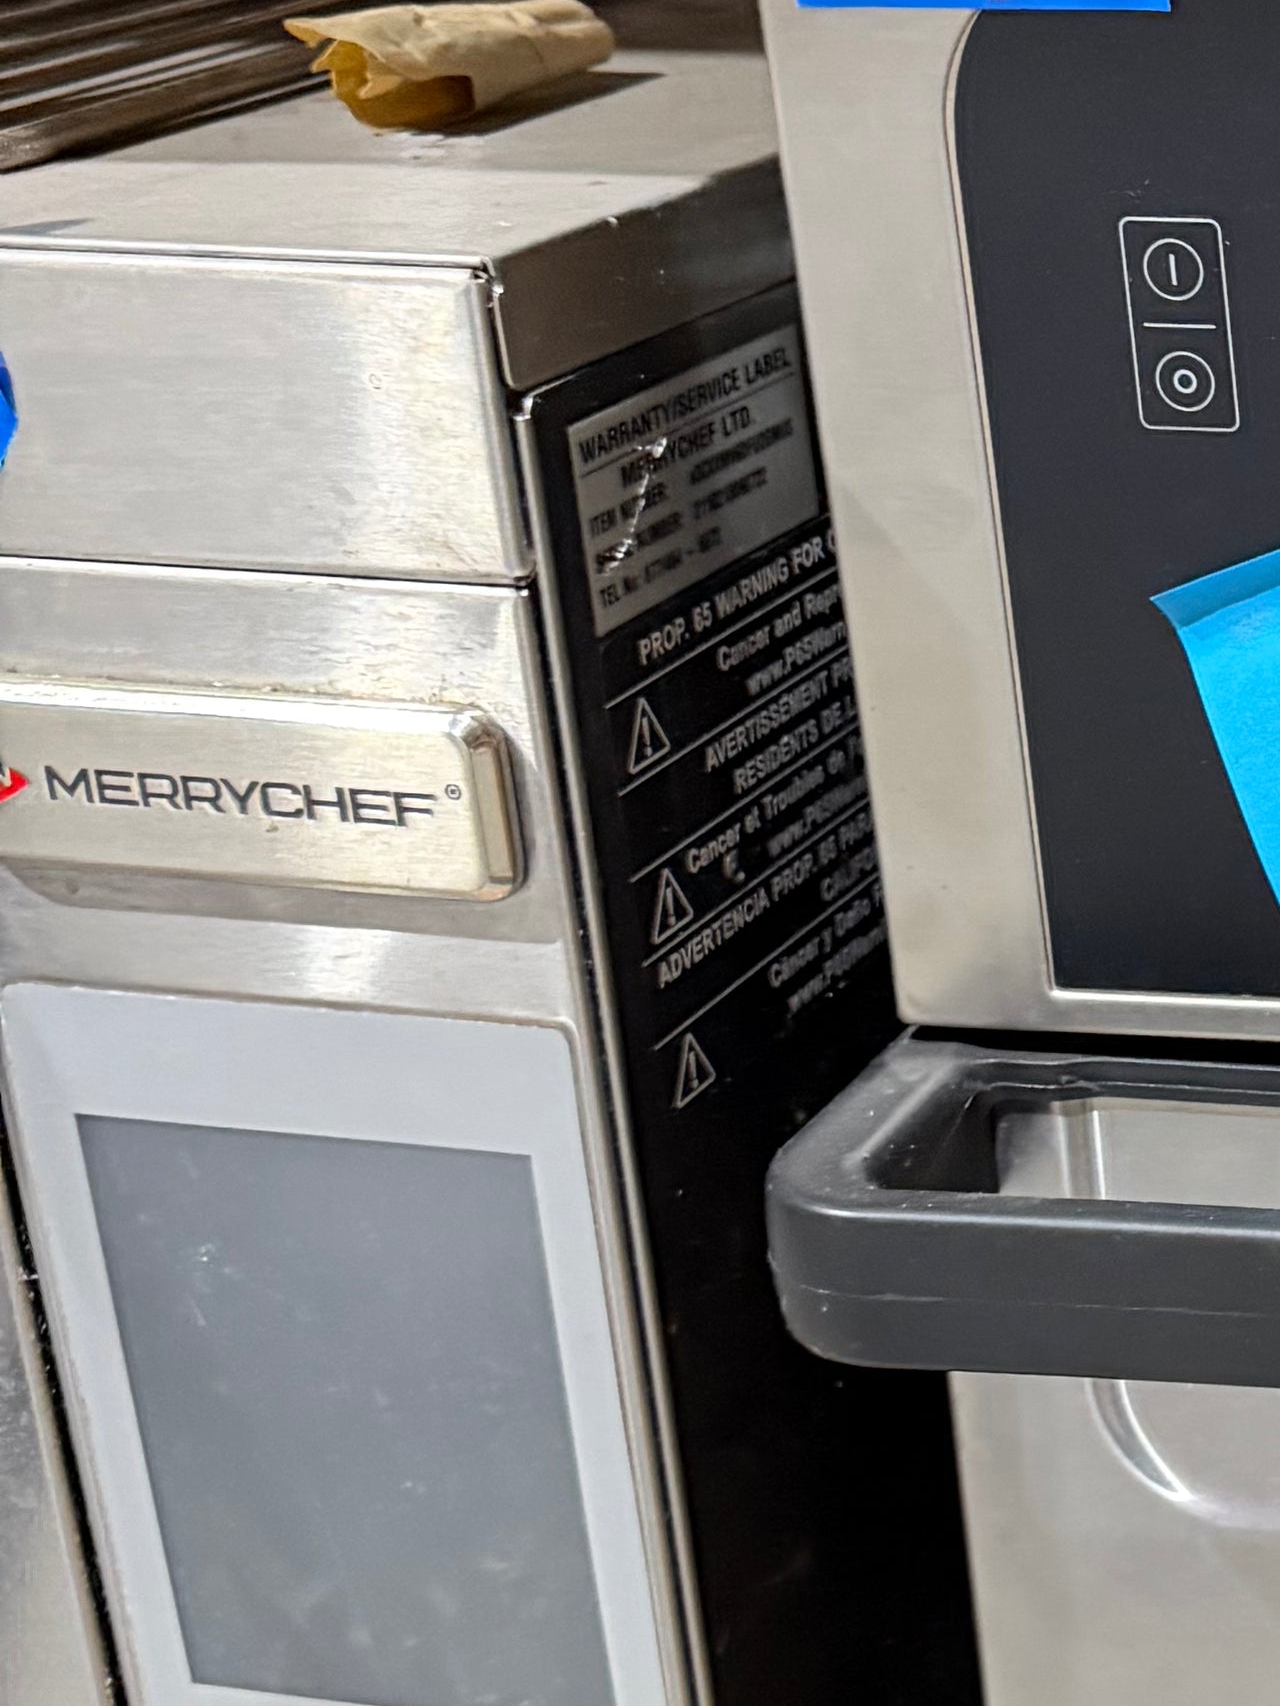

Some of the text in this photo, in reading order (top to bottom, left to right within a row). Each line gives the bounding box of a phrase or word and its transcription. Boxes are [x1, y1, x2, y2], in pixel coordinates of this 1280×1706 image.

[745, 347, 791, 384] LABEL
[638, 616, 691, 666] PROP.
[714, 556, 789, 620] WARNING
[791, 535, 826, 575] FOR
[716, 624, 771, 672] Cancer
[773, 599, 802, 638] and
[705, 670, 829, 774] AVERTISSEMENT
[44, 765, 436, 828] MERRYCHEF
[685, 823, 742, 874] Cancer
[658, 887, 770, 990] ADVERTENCIA
